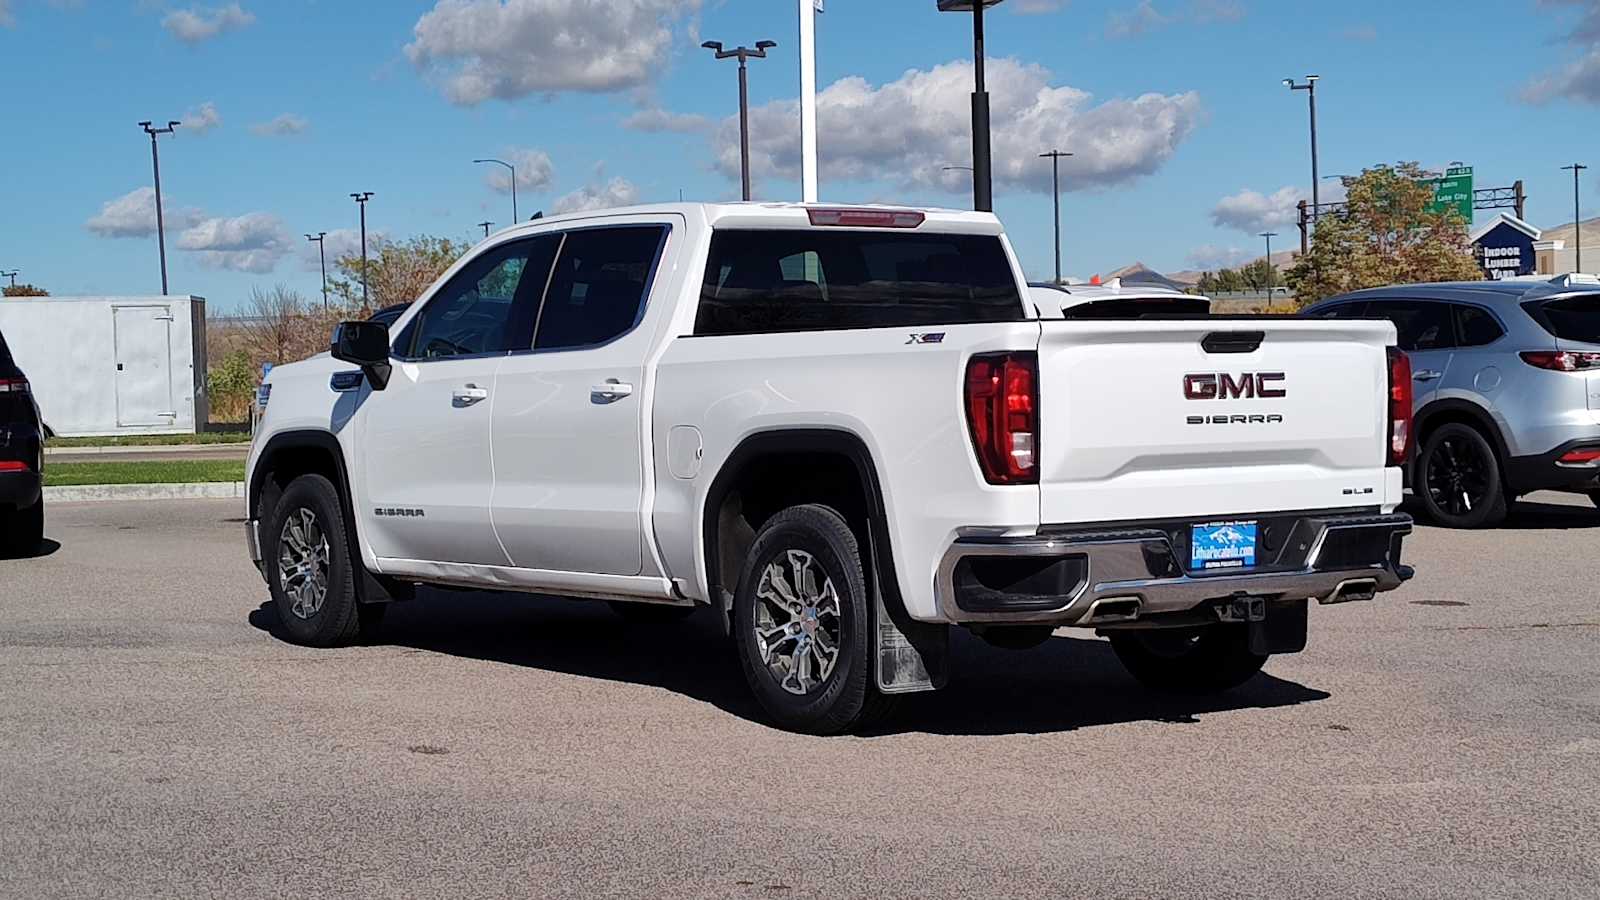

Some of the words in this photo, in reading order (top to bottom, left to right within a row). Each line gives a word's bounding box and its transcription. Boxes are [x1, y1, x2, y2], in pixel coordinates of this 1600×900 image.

[1454, 193, 1468, 201] City
[1485, 258, 1520, 269] LUMBER
[1184, 372, 1286, 400] GMC
[1186, 414, 1283, 424] SIERRA
[374, 508, 425, 517] SIERRA
